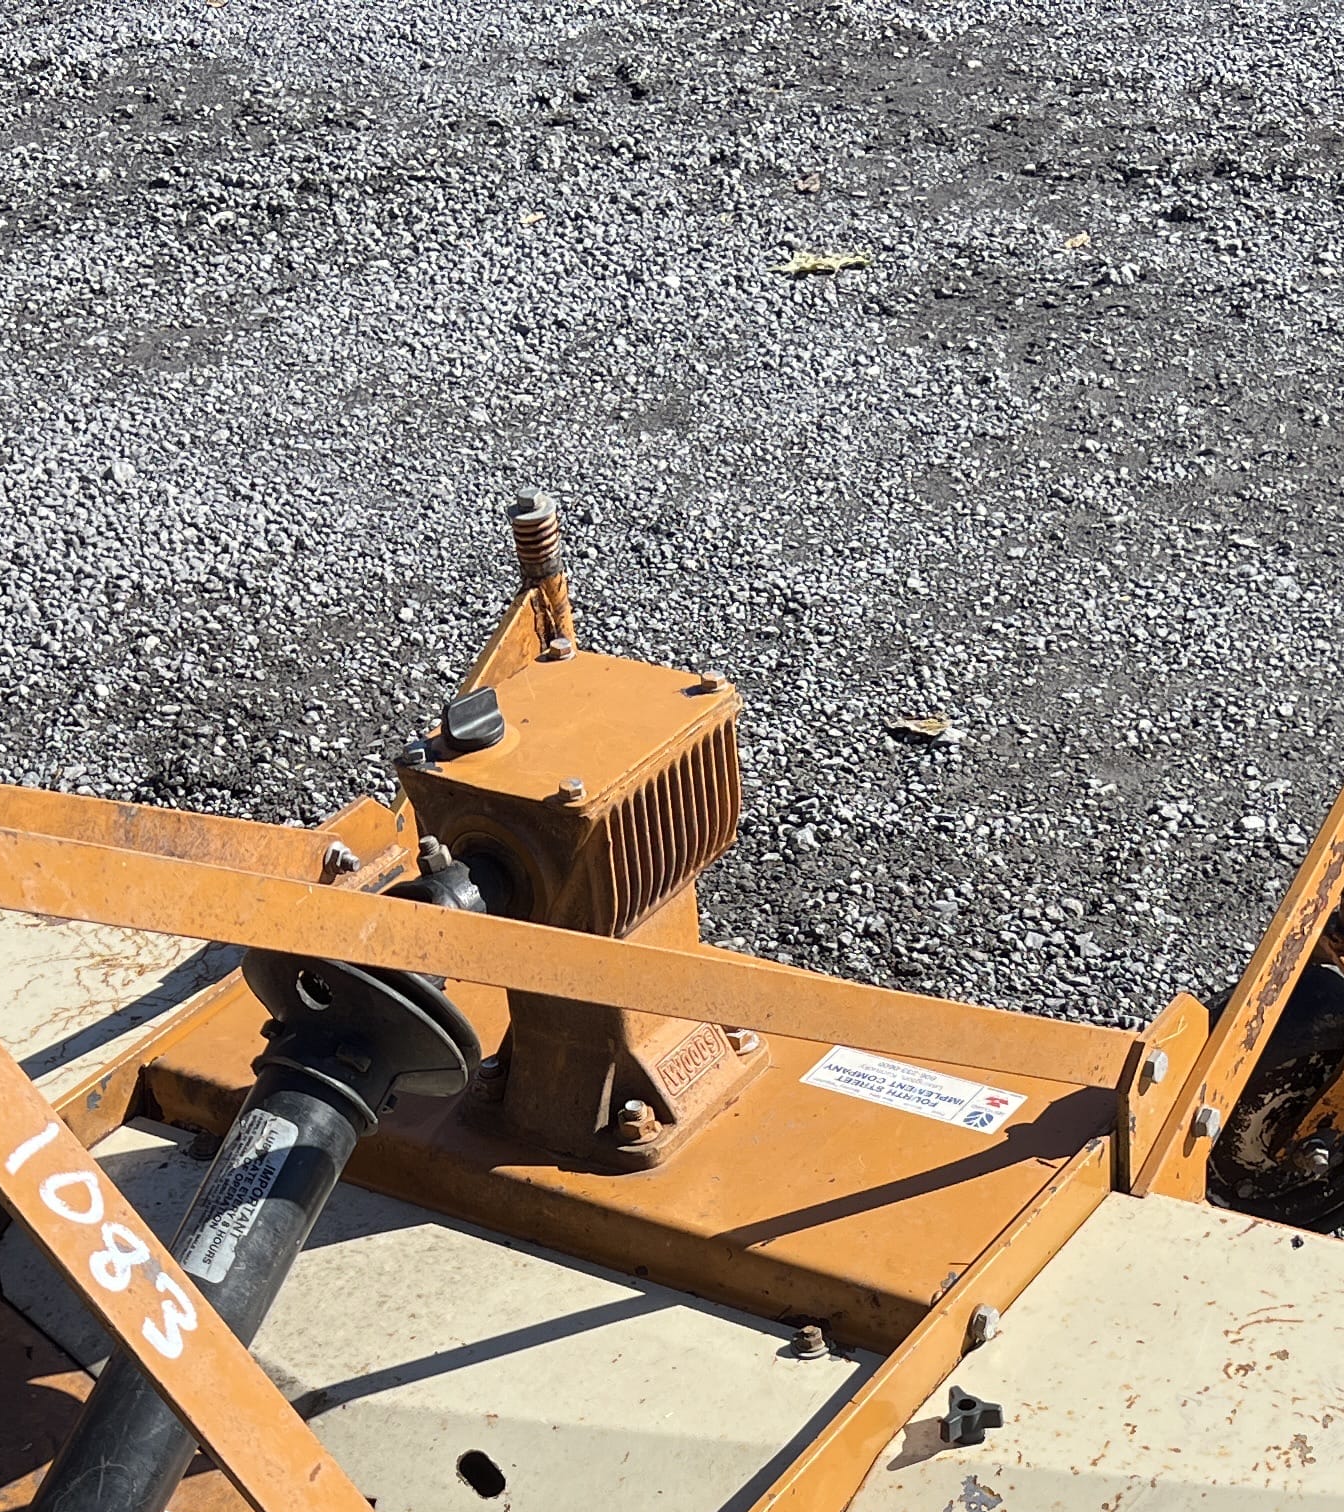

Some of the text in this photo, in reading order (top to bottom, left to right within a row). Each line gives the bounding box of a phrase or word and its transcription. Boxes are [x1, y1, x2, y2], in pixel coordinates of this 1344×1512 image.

[661, 1031, 716, 1087] WOODS
[822, 1062, 888, 1084] COMPANY
[833, 1074, 885, 1093] STREET
[884, 1088, 939, 1107] FOURTH
[887, 1080, 965, 1105] IMPLEMENT
[239, 1156, 252, 1172] OF
[243, 1129, 279, 1185] LUBCATE
[208, 1173, 243, 1230] OPERATION
[225, 1185, 249, 1219] EVERY
[228, 1163, 276, 1240] IMPORTANT
[5, 1122, 198, 1359] 1083
[220, 1219, 230, 1229] 8
[201, 1229, 226, 1265] HOURS
